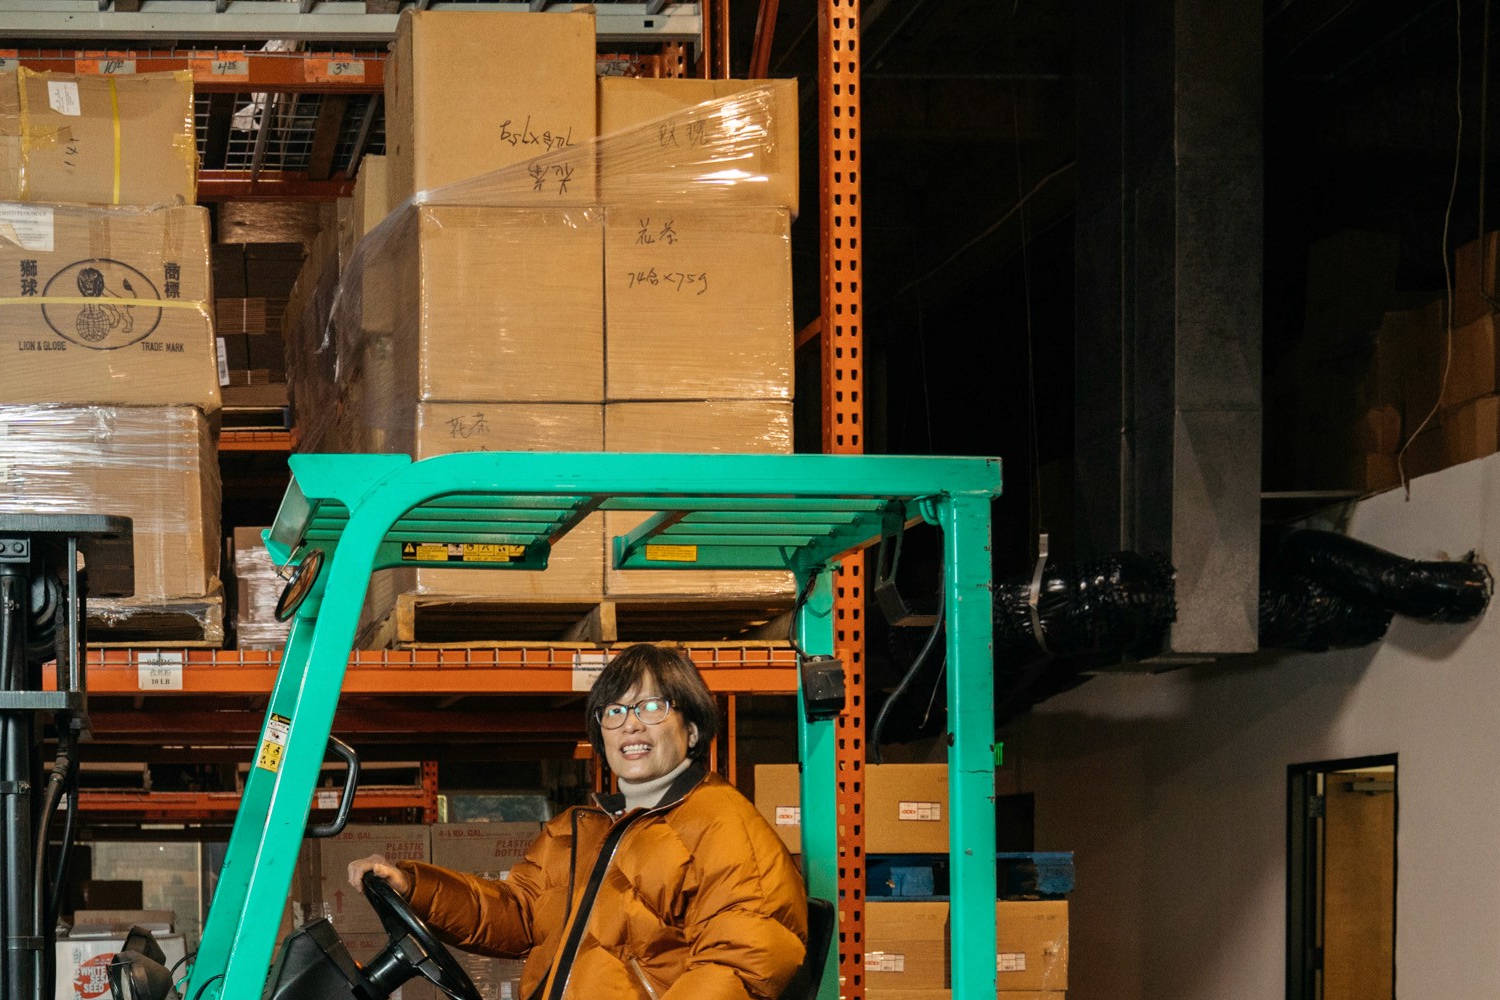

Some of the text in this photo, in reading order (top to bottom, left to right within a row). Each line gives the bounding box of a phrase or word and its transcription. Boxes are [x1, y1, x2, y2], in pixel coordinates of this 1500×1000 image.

[164, 262, 181, 299] 商標
[18, 341, 66, 351] LION & GLOBE
[142, 342, 184, 352] TRADE MARK
[386, 843, 424, 851] PLASTIC
[496, 839, 533, 848] PLASTIC
[385, 851, 424, 860] BOTTLES
[80, 966, 106, 976] WHITE
[84, 984, 104, 993] SEED
